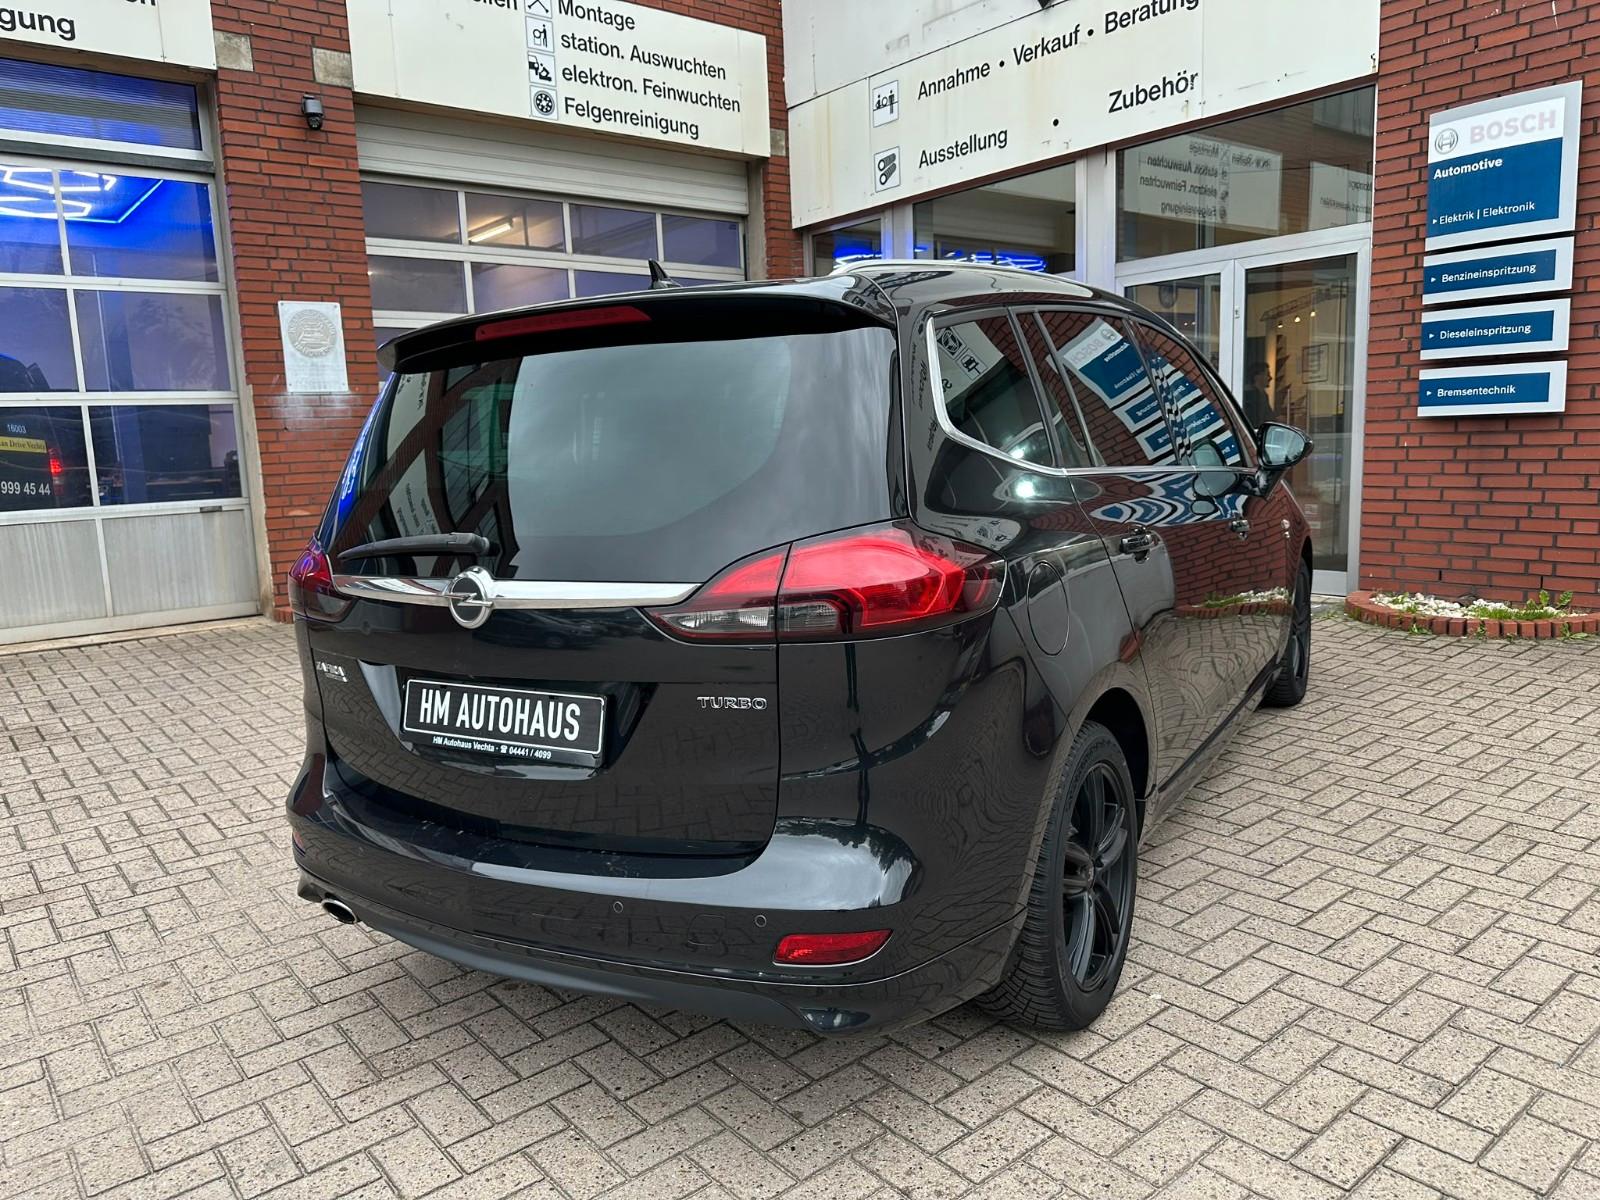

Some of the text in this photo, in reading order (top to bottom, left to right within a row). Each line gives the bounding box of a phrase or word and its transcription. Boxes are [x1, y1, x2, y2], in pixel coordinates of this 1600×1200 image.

[0, 8, 75, 41] gung
[559, 0, 635, 31] Montage
[561, 33, 726, 80] station. Auswuchten
[918, 61, 990, 100] Annahme
[1013, 25, 1080, 65] Verkauf
[562, 65, 741, 113] elektron. Feinwuchten
[1109, 70, 1199, 113] Zubehör
[565, 97, 699, 140] Felgenreinigung
[1470, 110, 1556, 144] BOSCH
[919, 130, 1008, 169] Ausstellung
[1434, 158, 1503, 179] Automotive
[1440, 210, 1474, 225] Elektrik
[1483, 201, 1535, 218] Elektronik
[1442, 262, 1536, 283] Benzineinspritzung
[1440, 323, 1531, 340] Dieseleinspritzung
[1437, 384, 1516, 397] Bremsentechnik
[1, 481, 50, 495] 999 45 44
[419, 689, 581, 741] HM AUTOHAUS
[697, 696, 767, 710] TURBO
[432, 736, 442, 744] HM
[443, 737, 472, 749] Autohaus
[473, 741, 495, 752] Vechta
[508, 746, 529, 757] 04441
[534, 749, 552, 759] 4099
